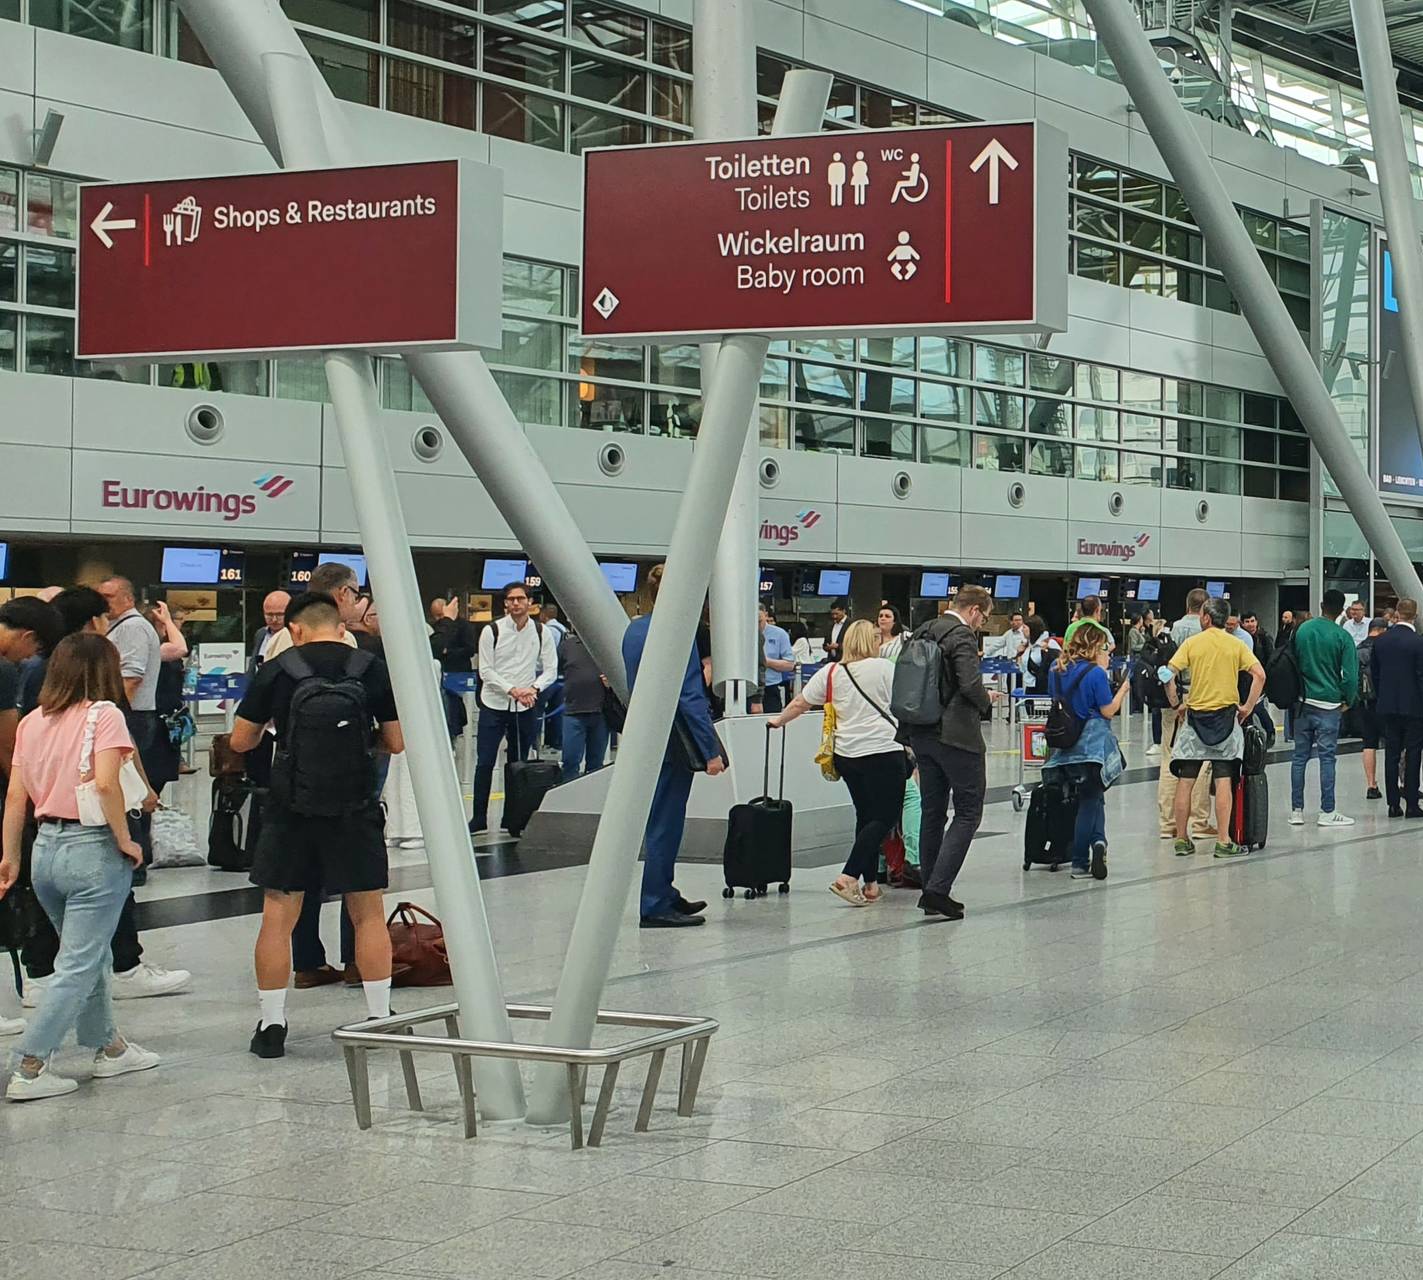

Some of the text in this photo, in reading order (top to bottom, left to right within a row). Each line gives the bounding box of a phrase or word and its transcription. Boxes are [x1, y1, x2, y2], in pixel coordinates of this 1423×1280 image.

[704, 152, 811, 180] Toiletten
[880, 149, 904, 161] WC
[734, 185, 810, 212] Toilets
[213, 194, 436, 233] Shops & Restaurants
[717, 228, 865, 257] Wickelraum
[737, 263, 865, 294] Baby room
[102, 480, 256, 521] Eurowings
[1077, 538, 1136, 562] Eurowings
[220, 568, 242, 581] 161
[291, 570, 311, 582] 160
[525, 576, 541, 587] 159
[759, 581, 773, 591] 157
[802, 583, 815, 593] 156
